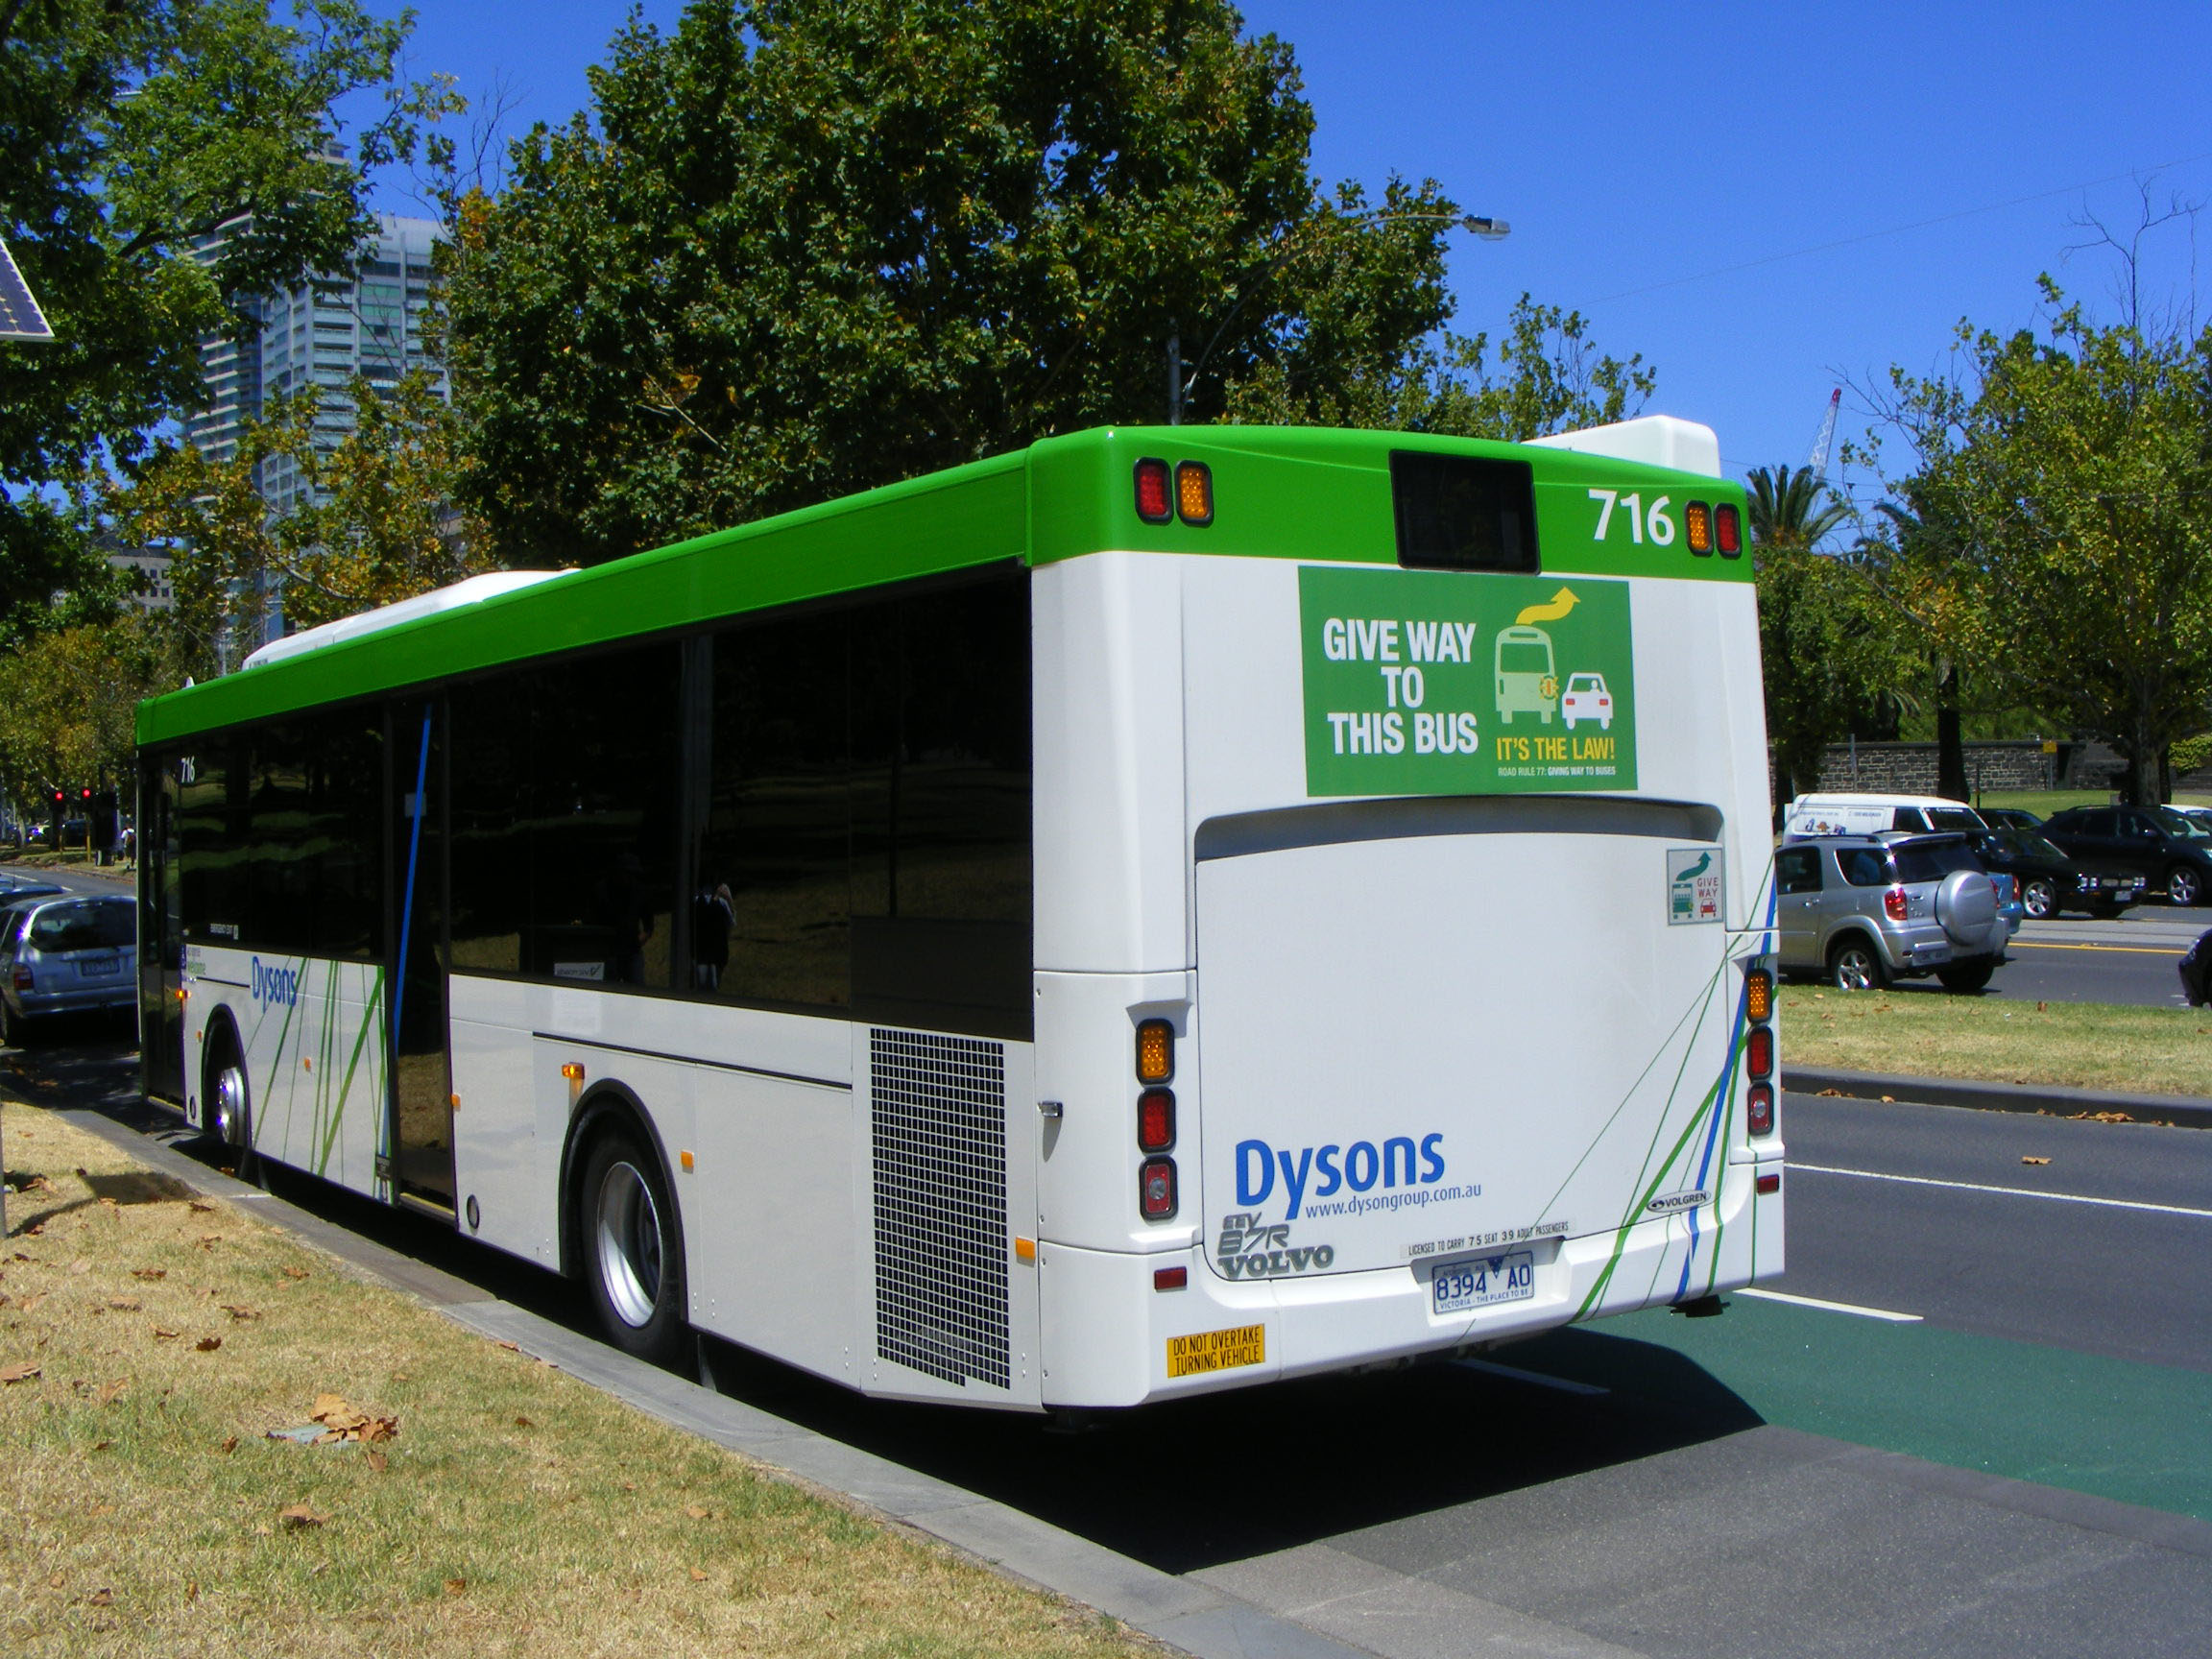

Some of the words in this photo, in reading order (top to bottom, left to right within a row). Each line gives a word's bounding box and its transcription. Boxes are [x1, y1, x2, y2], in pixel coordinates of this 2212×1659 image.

[1588, 488, 1675, 546] 716
[1323, 617, 1400, 661] GIVE
[1406, 620, 1477, 662] WAY
[1381, 666, 1425, 709] TO
[1327, 711, 1405, 755] THIS
[1415, 712, 1479, 755] BUS
[1497, 736, 1530, 760] IT'S
[1534, 736, 1568, 760] THE
[1573, 736, 1615, 760] LAW!
[181, 756, 195, 782] 716
[1498, 767, 1517, 777] ROAD
[1518, 767, 1535, 777] RULE
[1548, 766, 1570, 777] GIVING
[1570, 766, 1585, 777] WAY
[1586, 766, 1595, 777] TO
[1595, 766, 1616, 776] BUSES
[1697, 877, 1719, 886] GIVE
[1697, 888, 1718, 898] WAY
[252, 956, 297, 1014] Dysons
[1236, 1133, 1445, 1221] Dysons
[1306, 1184, 1481, 1218] www.dysongroup.com.au
[1665, 1192, 1707, 1207] VOLGREN
[1408, 1242, 1435, 1256] LICENSED
[1438, 1240, 1445, 1251] TO
[1447, 1238, 1465, 1250] CARRY
[1484, 1233, 1498, 1243] SEAT
[1517, 1228, 1533, 1238] ADULT
[1535, 1221, 1569, 1236] PASSENGERS
[1217, 1244, 1334, 1280] VOLVO
[1436, 1270, 1487, 1301] 8394
[1440, 1299, 1471, 1310] VICTORIA
[1490, 1292, 1509, 1301] PLACE
[1173, 1337, 1187, 1356] DO
[1190, 1334, 1209, 1353] NOT
[1211, 1326, 1261, 1350] OVERTAKE
[1174, 1352, 1217, 1376] TURNING
[1219, 1344, 1260, 1367] VEHICLE
